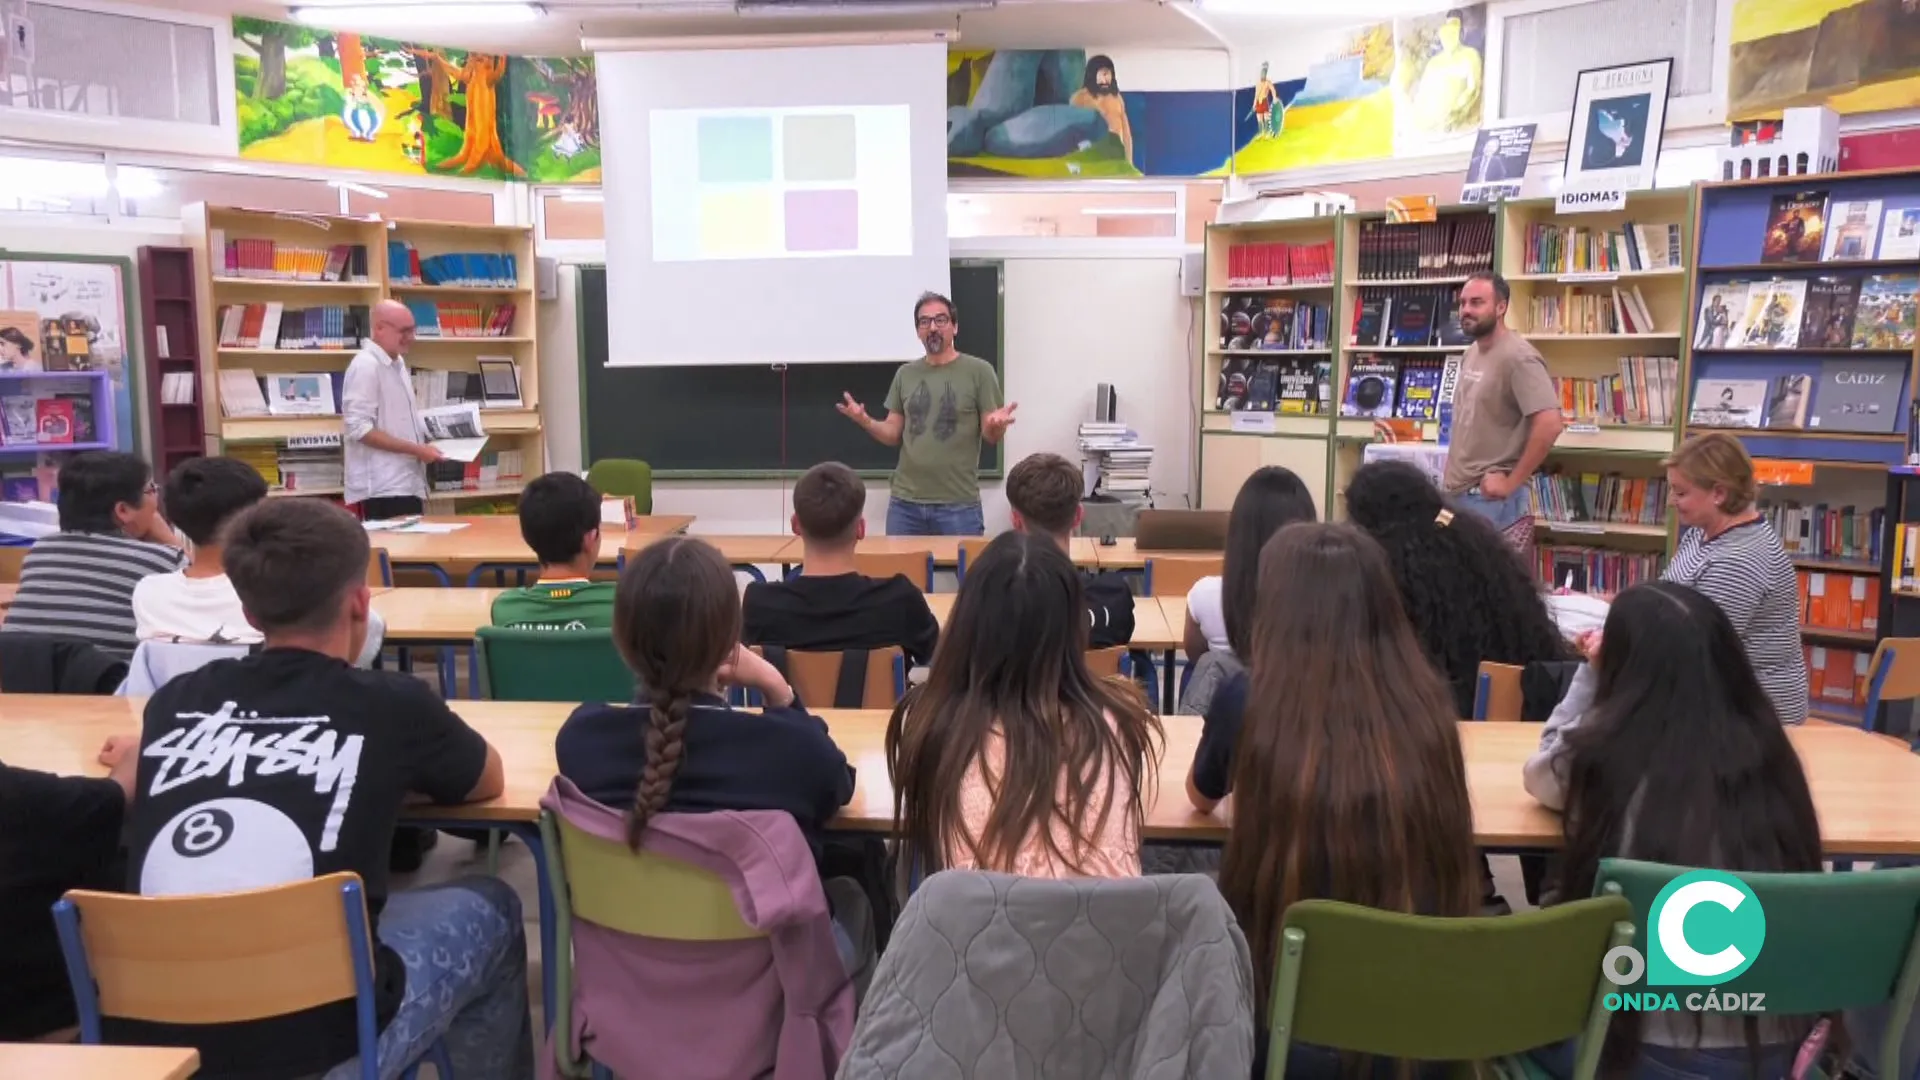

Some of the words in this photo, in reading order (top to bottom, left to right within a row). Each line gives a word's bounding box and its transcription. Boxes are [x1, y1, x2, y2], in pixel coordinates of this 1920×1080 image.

[1561, 190, 1620, 205] IDIOMAS
[1280, 375, 1314, 384] UNIVERSO
[1835, 369, 1888, 385] CÁDIZ
[289, 434, 339, 446] REVISTAS
[183, 811, 223, 852] 8
